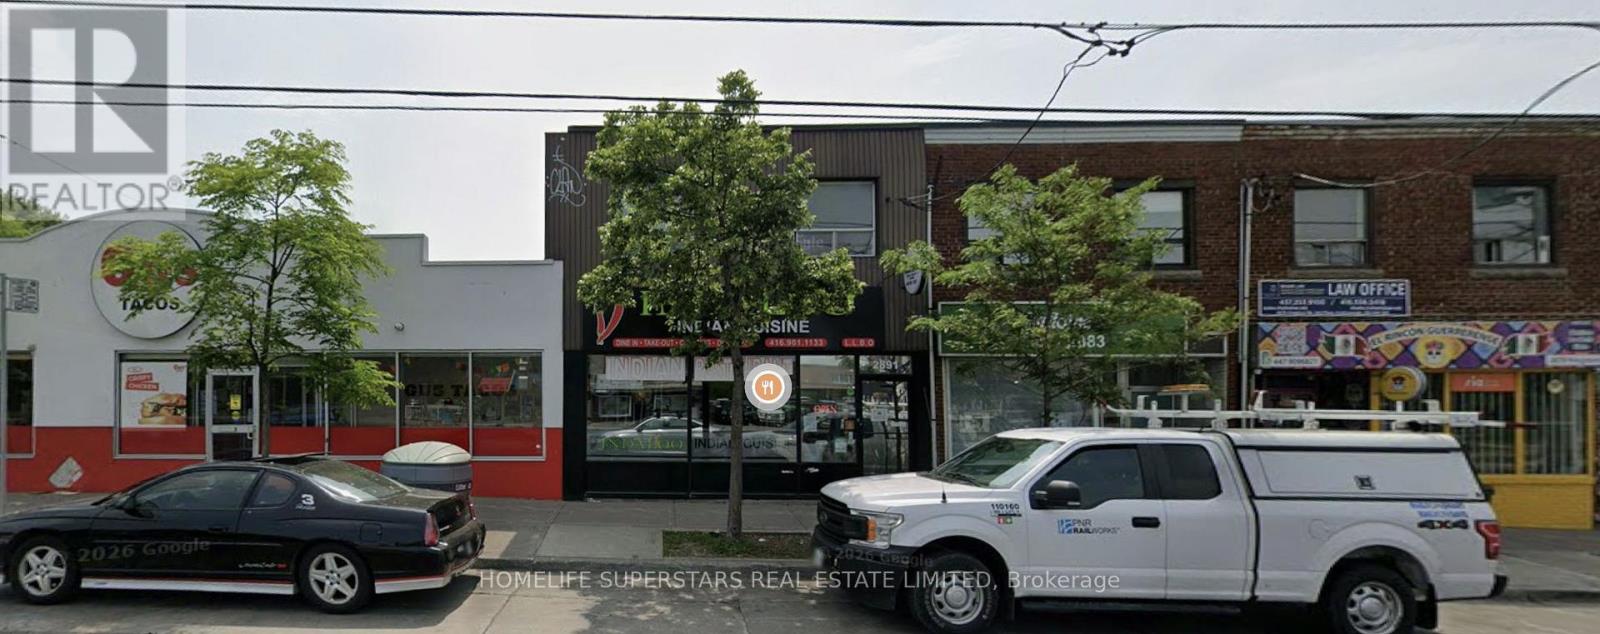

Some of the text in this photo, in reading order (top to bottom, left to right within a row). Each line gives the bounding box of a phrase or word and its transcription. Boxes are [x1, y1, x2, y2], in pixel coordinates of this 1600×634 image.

[1328, 283, 1357, 296] LAW
[1358, 283, 1406, 296] OFFICE
[120, 296, 181, 311] TACOS
[744, 320, 811, 334] UISINE
[873, 361, 899, 370] 2891
[302, 494, 315, 505] 3
